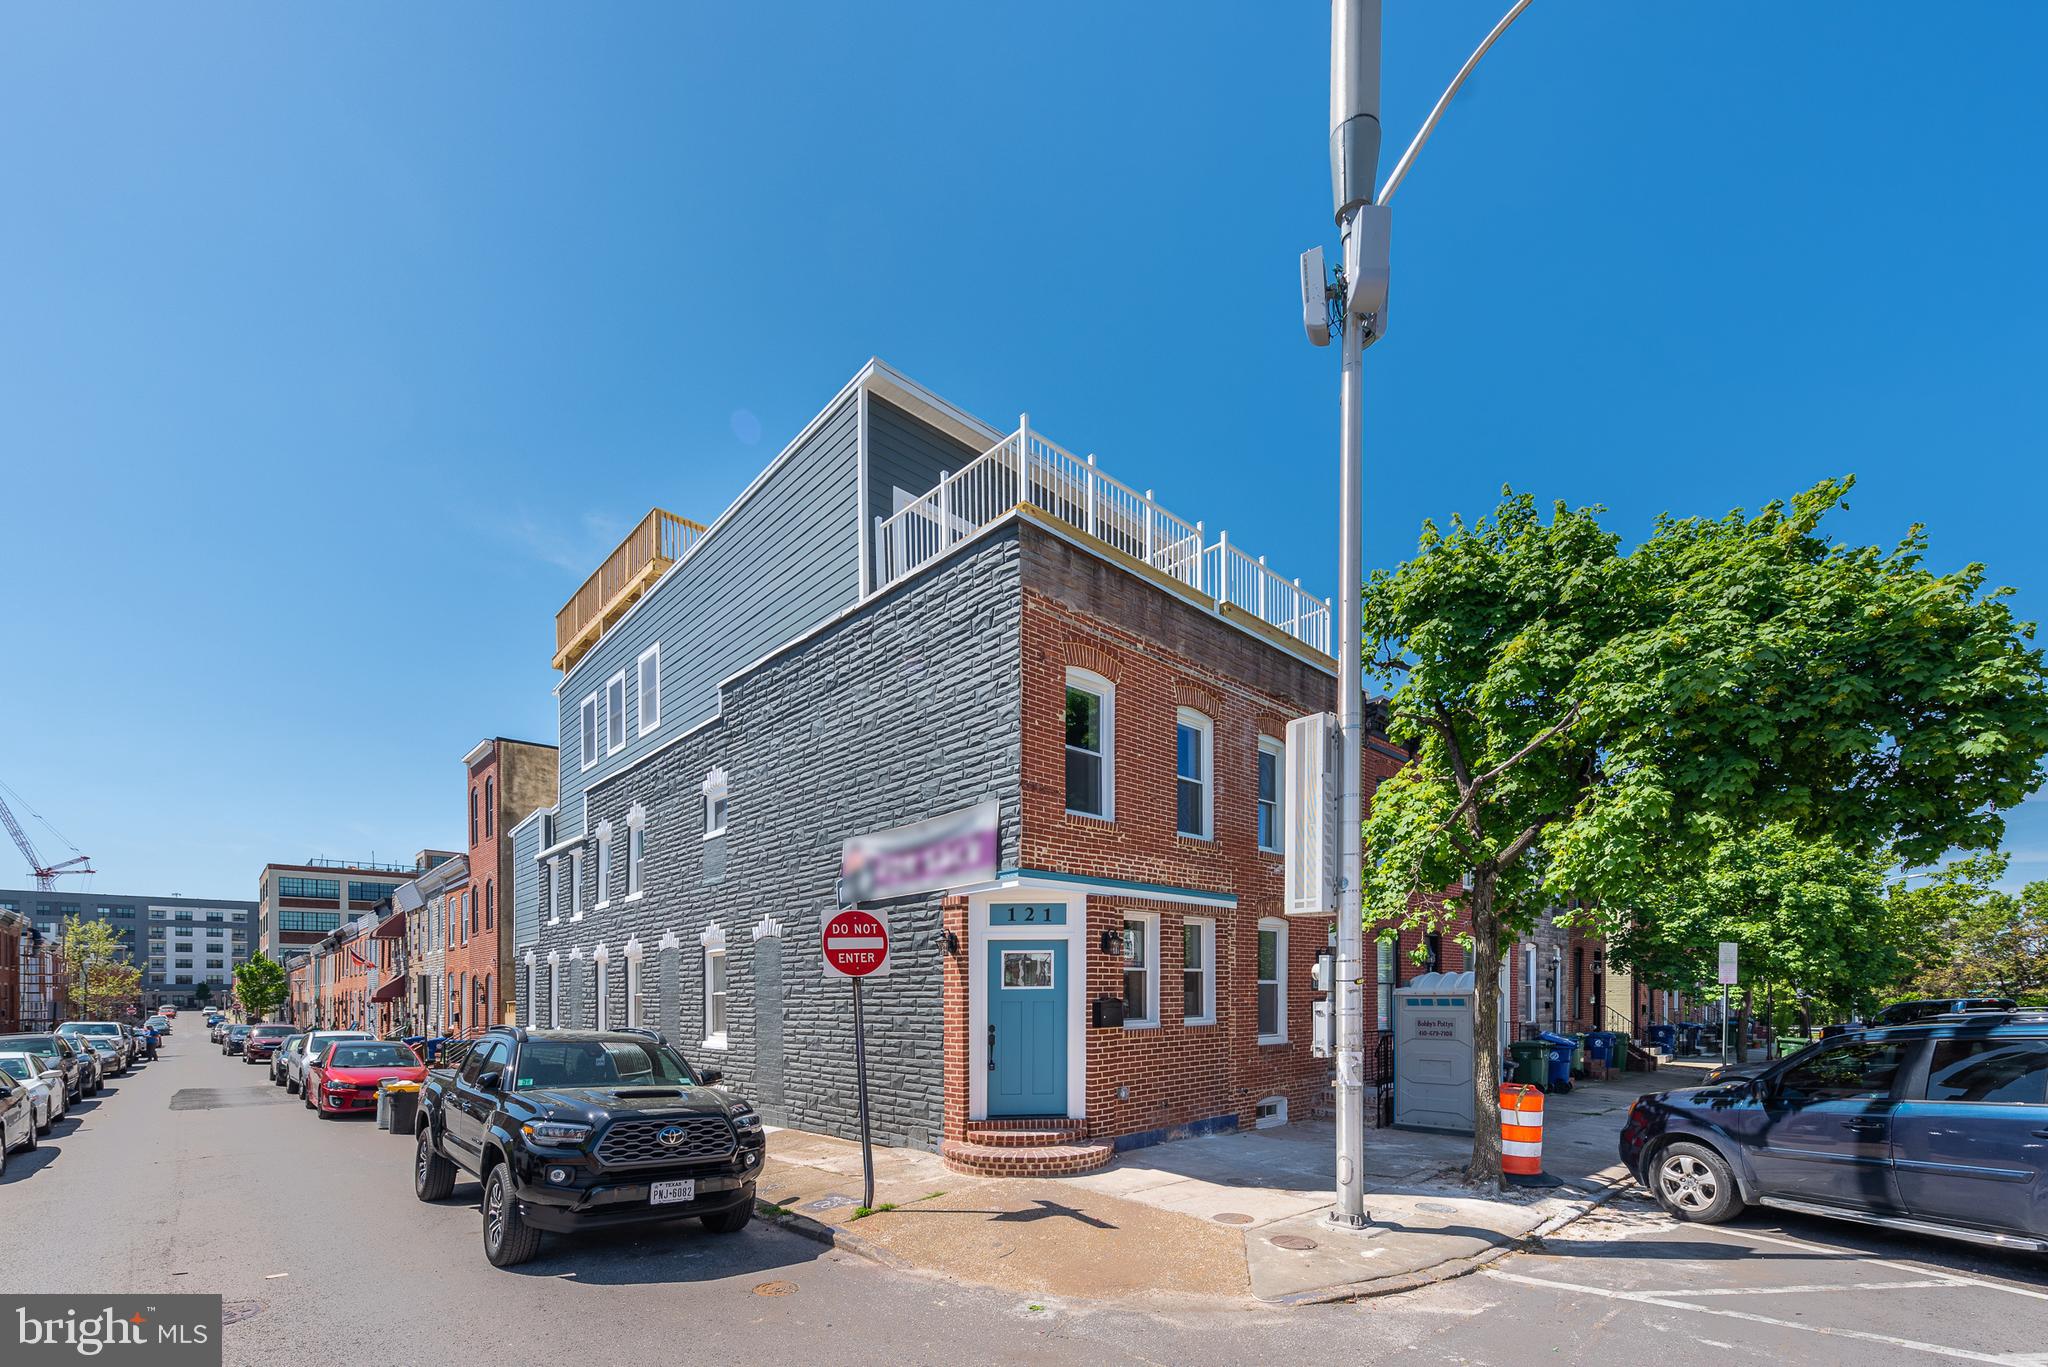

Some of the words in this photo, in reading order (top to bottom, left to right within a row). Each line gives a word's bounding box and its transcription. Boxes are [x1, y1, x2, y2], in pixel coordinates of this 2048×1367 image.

[1008, 907, 1051, 922] 121
[832, 923, 848, 934] DO
[854, 923, 877, 934] NOT
[838, 952, 875, 963] ENTER
